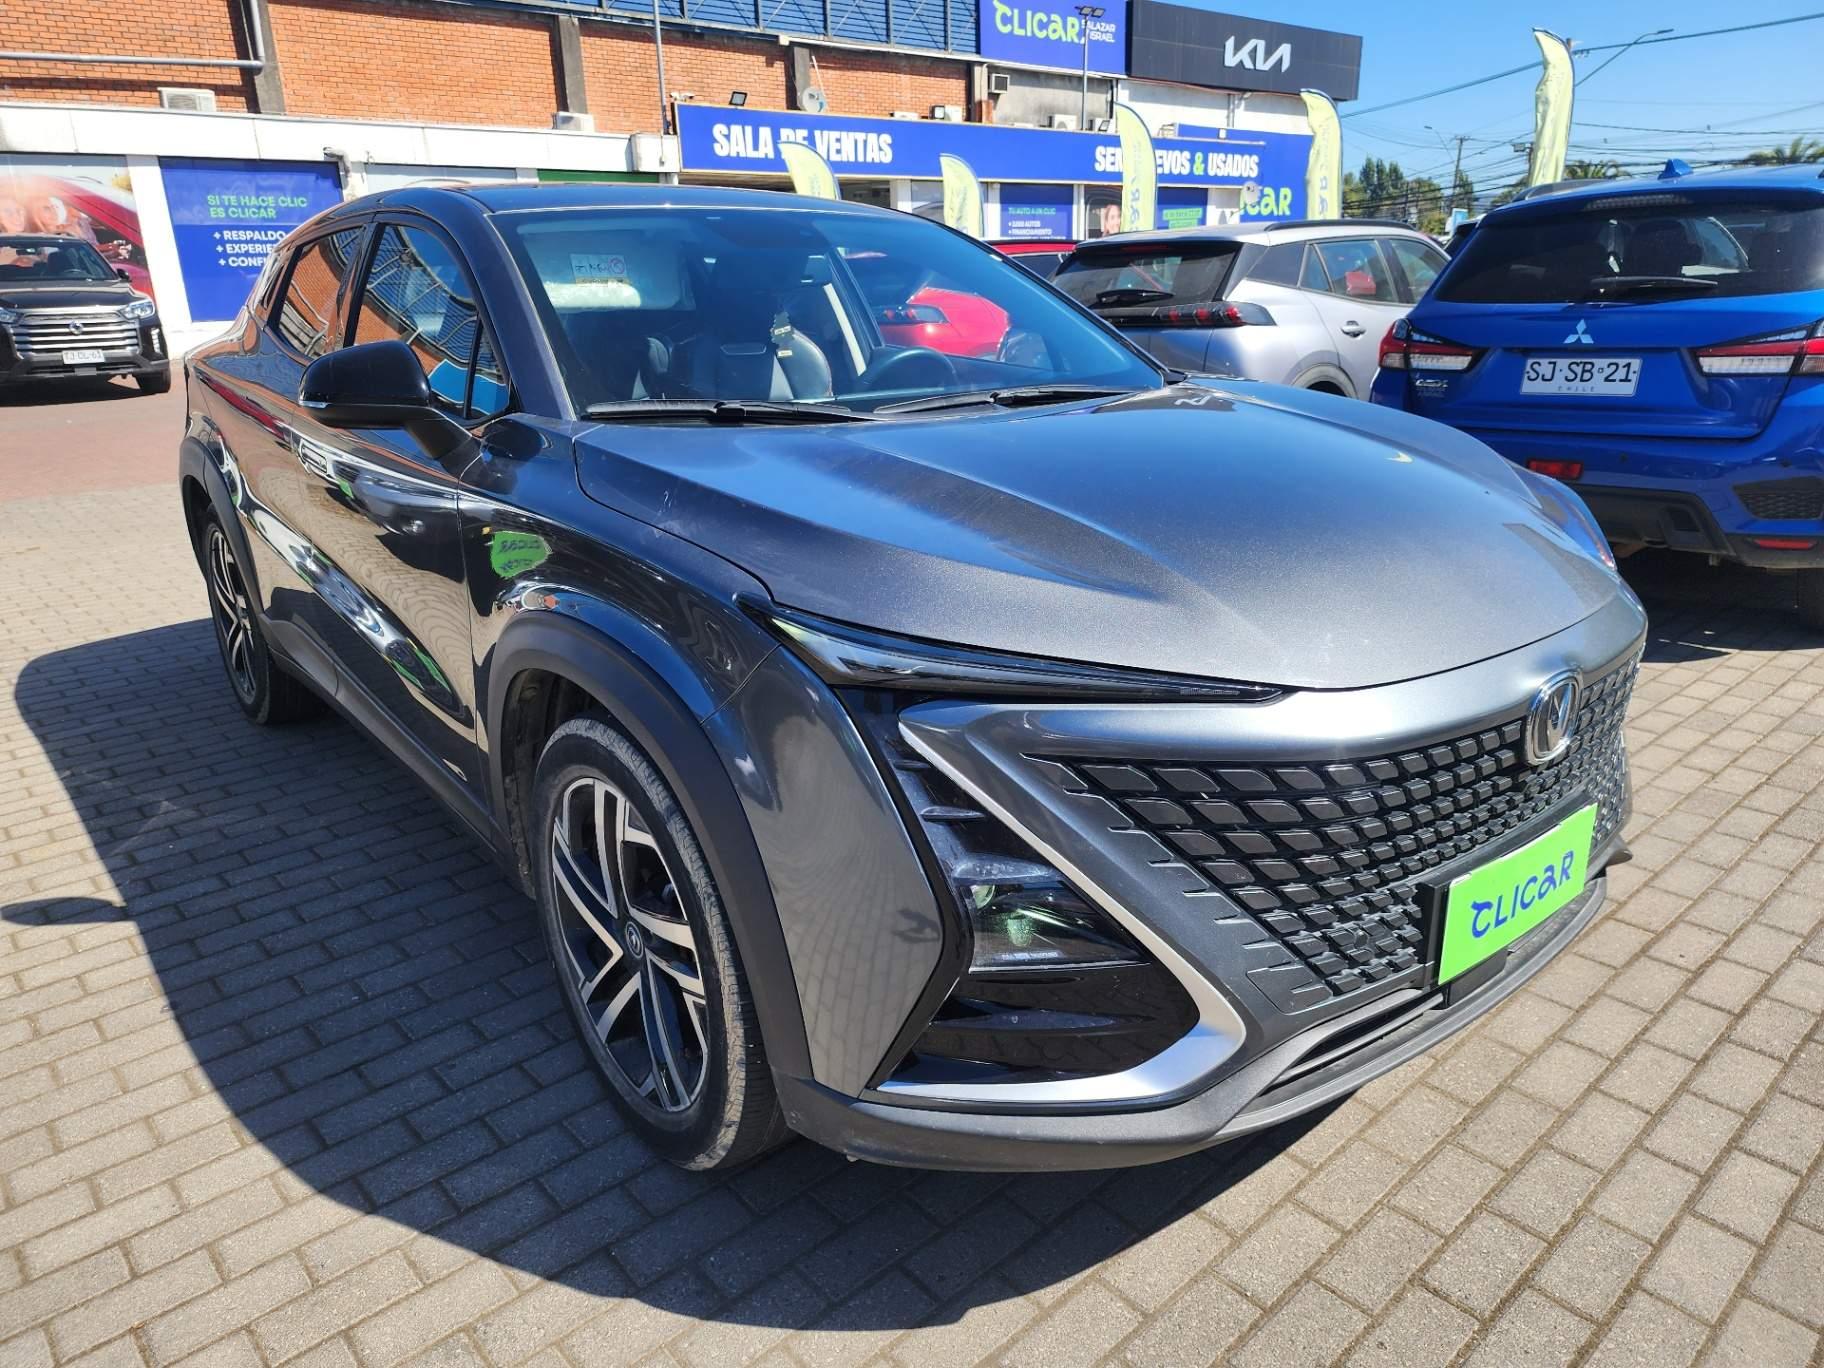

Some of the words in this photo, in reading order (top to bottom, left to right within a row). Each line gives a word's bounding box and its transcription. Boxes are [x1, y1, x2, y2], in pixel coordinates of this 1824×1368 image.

[1224, 35, 1292, 73] KIA
[712, 123, 775, 159] SALA
[814, 129, 893, 164] VENTAS
[1193, 151, 1205, 176] &
[1207, 152, 1260, 178] USADOS
[207, 194, 220, 206] SI
[222, 195, 238, 206] TE
[240, 195, 276, 207] HACE
[277, 196, 308, 208] CLIC
[209, 207, 226, 218] ES
[228, 207, 276, 219] CLICAR
[1470, 850, 1575, 939] CLICAR
